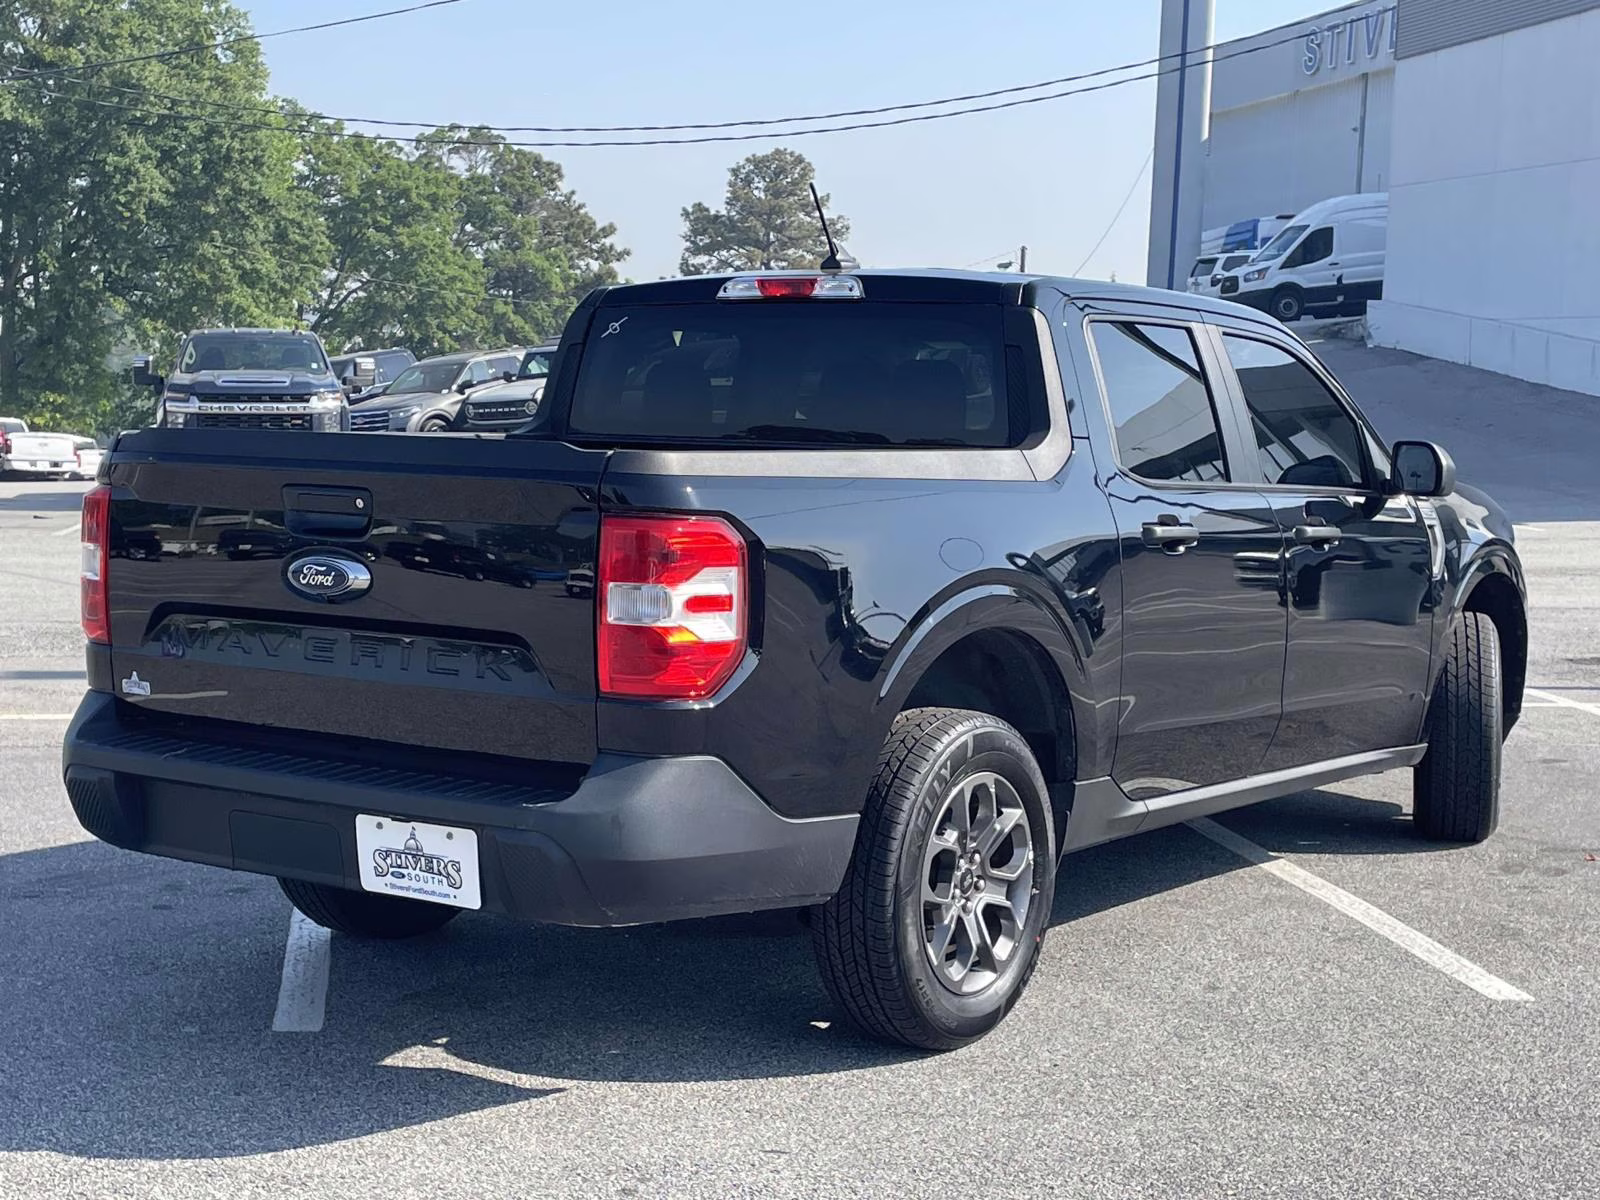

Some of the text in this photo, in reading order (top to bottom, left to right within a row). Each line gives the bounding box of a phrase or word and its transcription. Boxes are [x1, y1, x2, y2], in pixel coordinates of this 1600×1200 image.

[299, 564, 335, 586] Ford
[170, 622, 516, 682] MAVERICK
[407, 872, 444, 887] SOUTH
